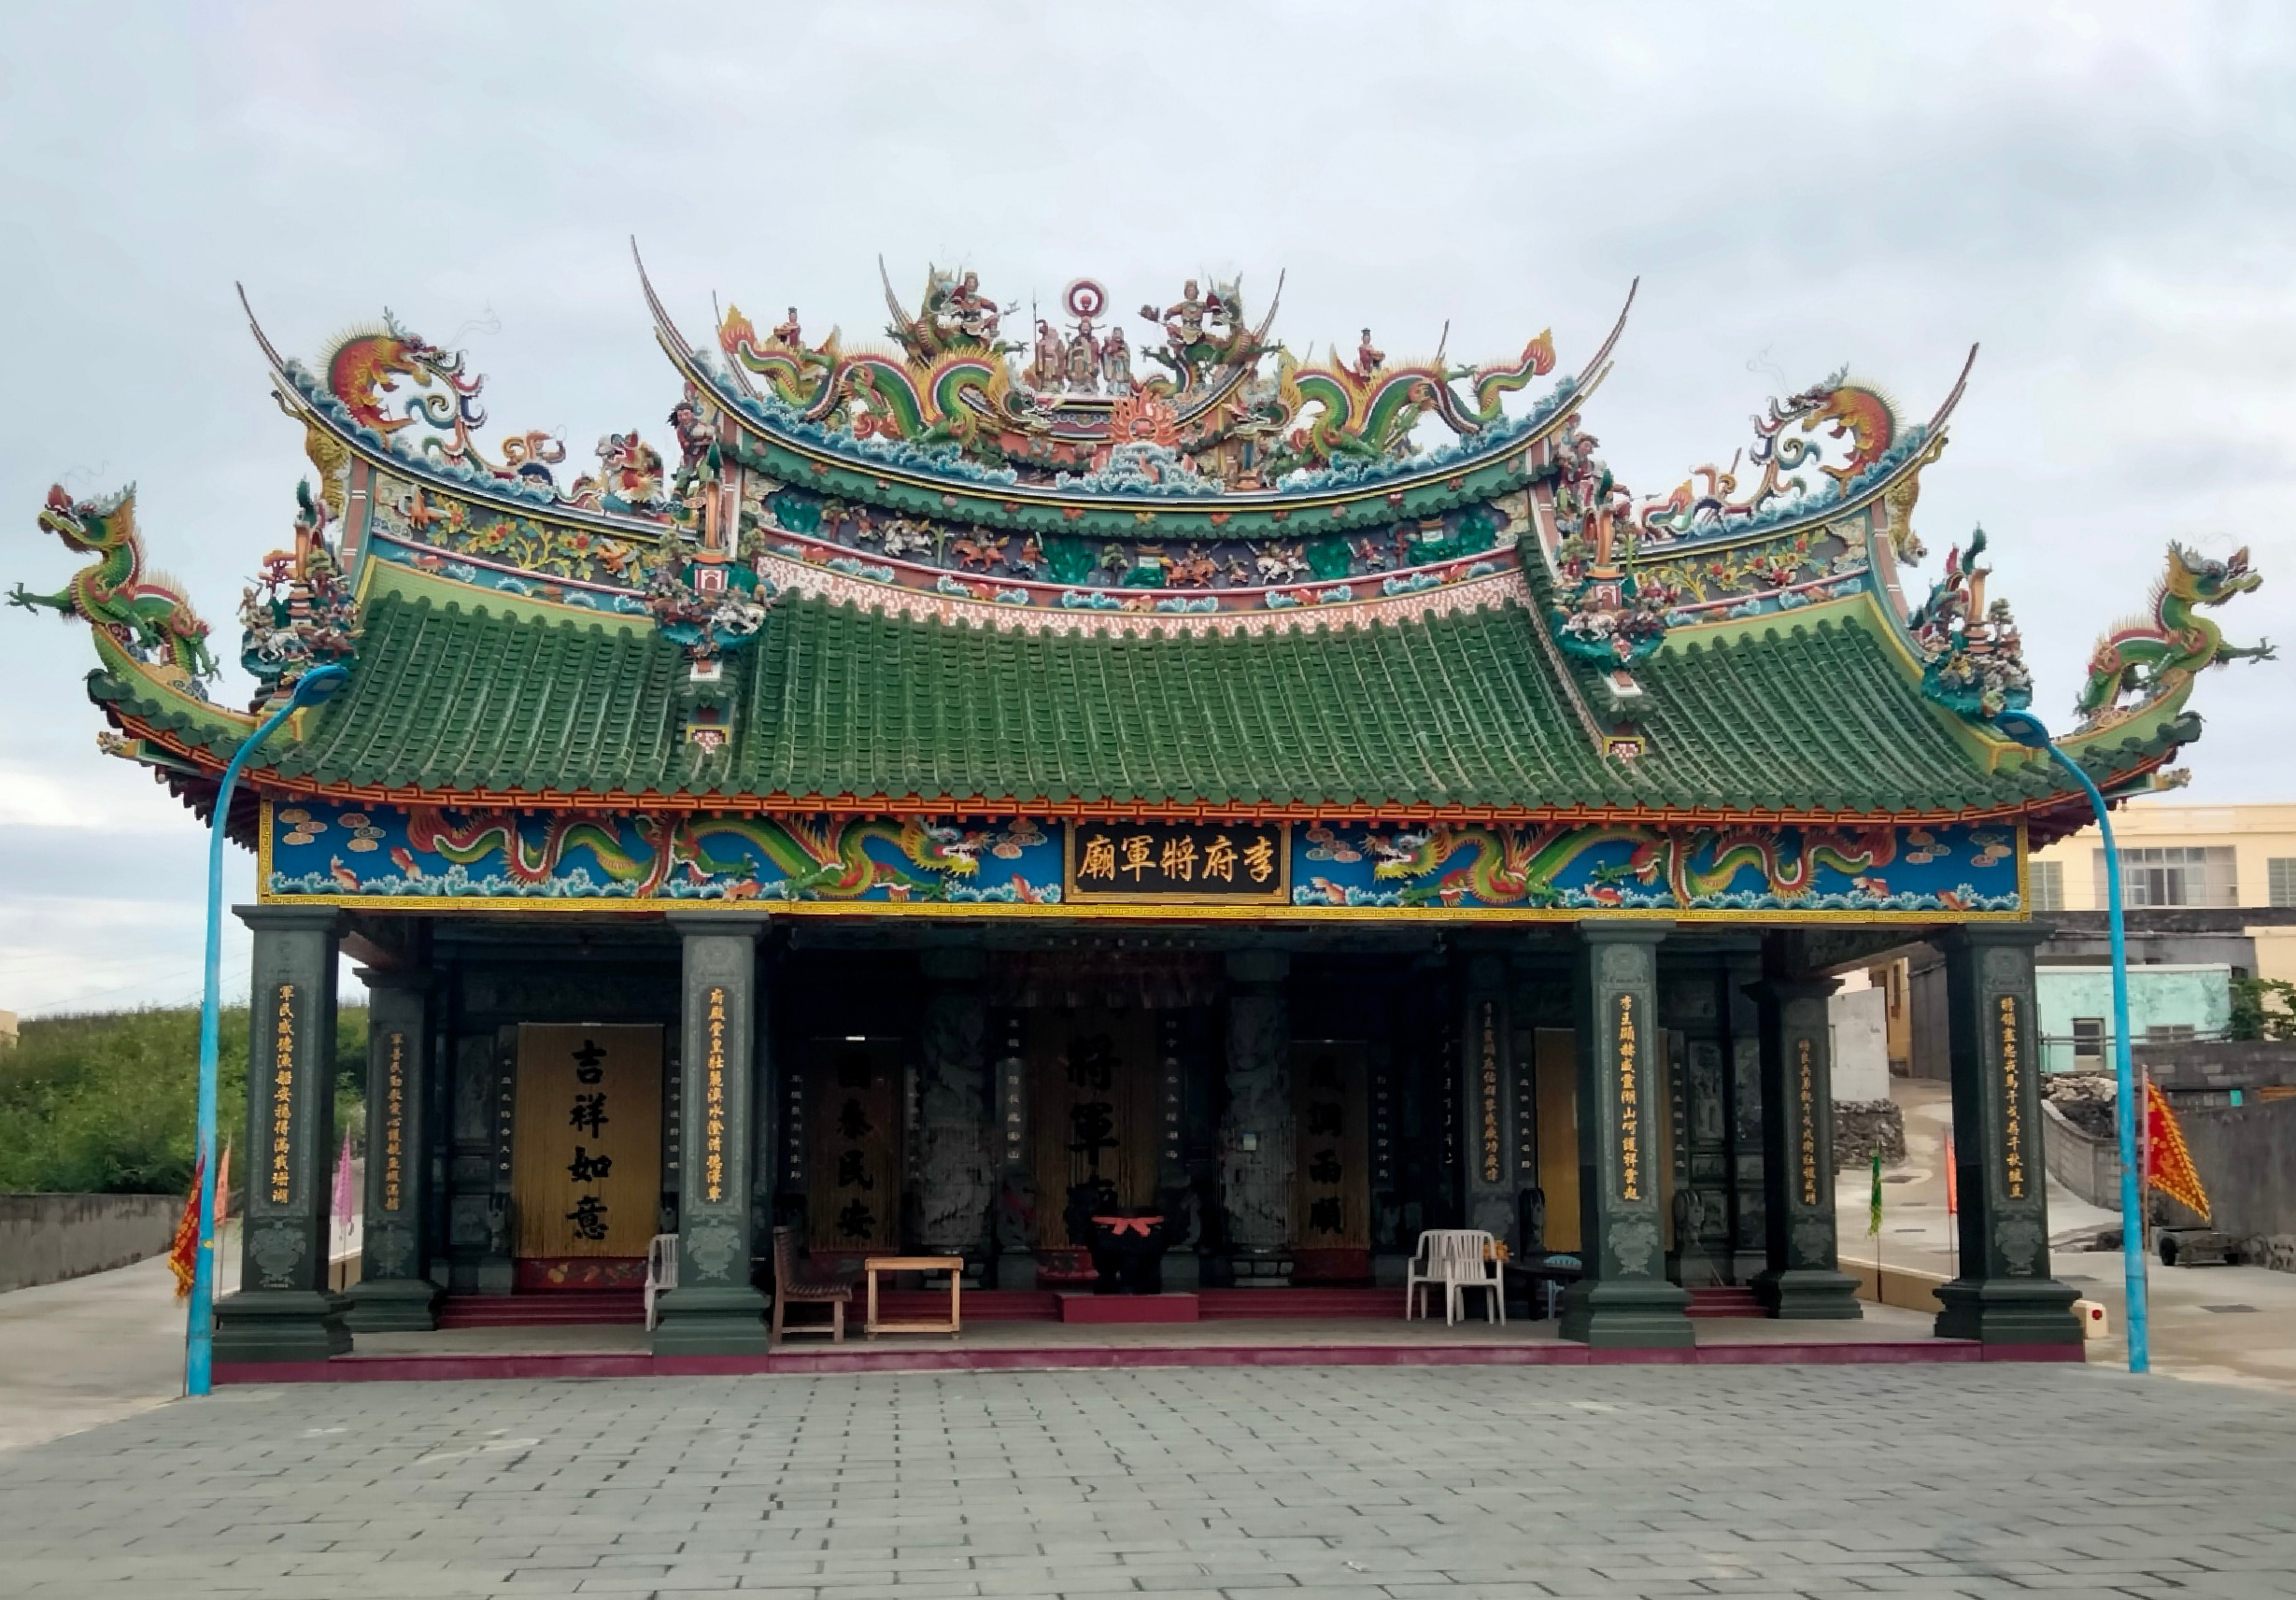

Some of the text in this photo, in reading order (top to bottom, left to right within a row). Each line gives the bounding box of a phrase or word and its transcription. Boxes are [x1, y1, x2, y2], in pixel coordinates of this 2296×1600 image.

[1078, 834, 1273, 882] 李府將軍廟
[566, 1040, 612, 1240] 吉祥如意
